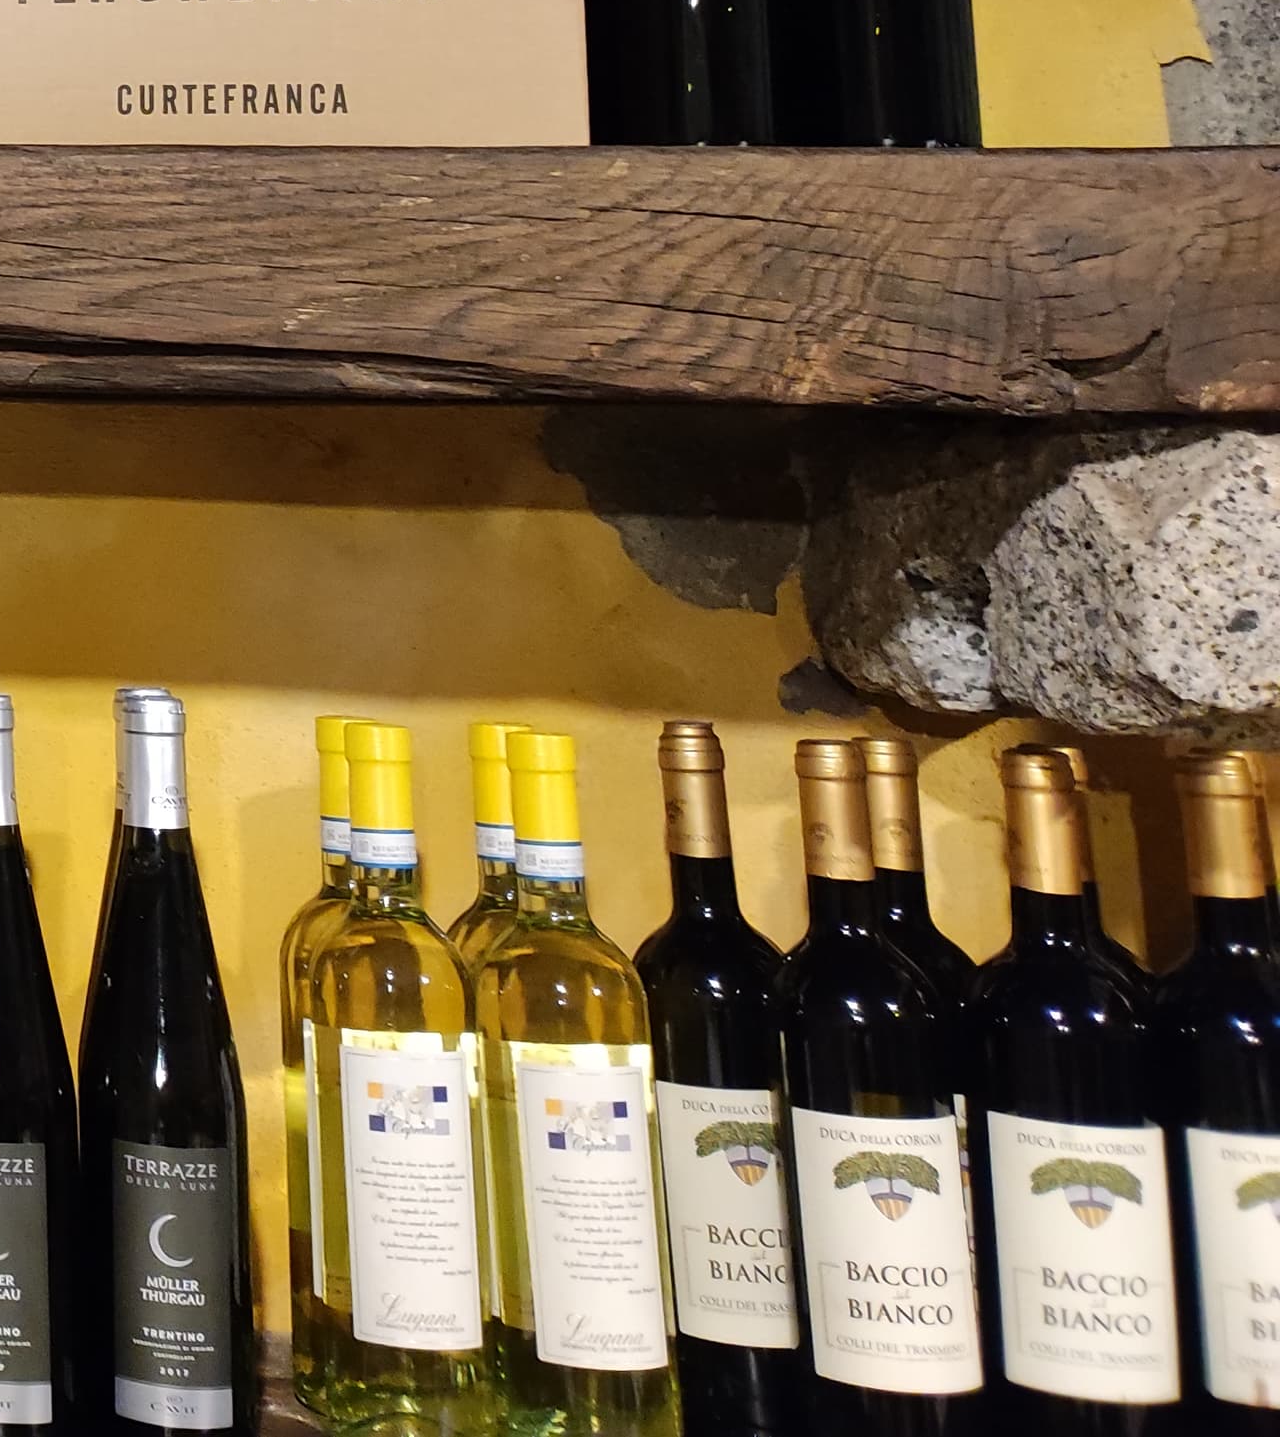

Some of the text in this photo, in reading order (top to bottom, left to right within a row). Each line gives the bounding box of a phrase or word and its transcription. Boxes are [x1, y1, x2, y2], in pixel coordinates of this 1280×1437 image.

[116, 82, 348, 115] CURTEFRANCA
[681, 1099, 717, 1115] DUCA
[719, 1104, 750, 1116] DELLA
[819, 1127, 943, 1147] DUCA DELLA CORGNA
[1016, 1132, 1055, 1149] DUCA
[123, 1154, 219, 1180] TERRAZZE
[125, 1175, 217, 1192] DELLA LUNA
[707, 1223, 786, 1250] BACCI
[146, 1274, 200, 1293] MÜLLER
[709, 1259, 788, 1285] BIANC
[846, 1260, 949, 1288] BACCIO
[1040, 1266, 1149, 1298] BACCIO
[140, 1287, 206, 1307] THURGAU
[847, 1297, 954, 1326] BIANCO
[1041, 1304, 1153, 1337] BIANCO
[142, 1326, 206, 1343] TRENTINO
